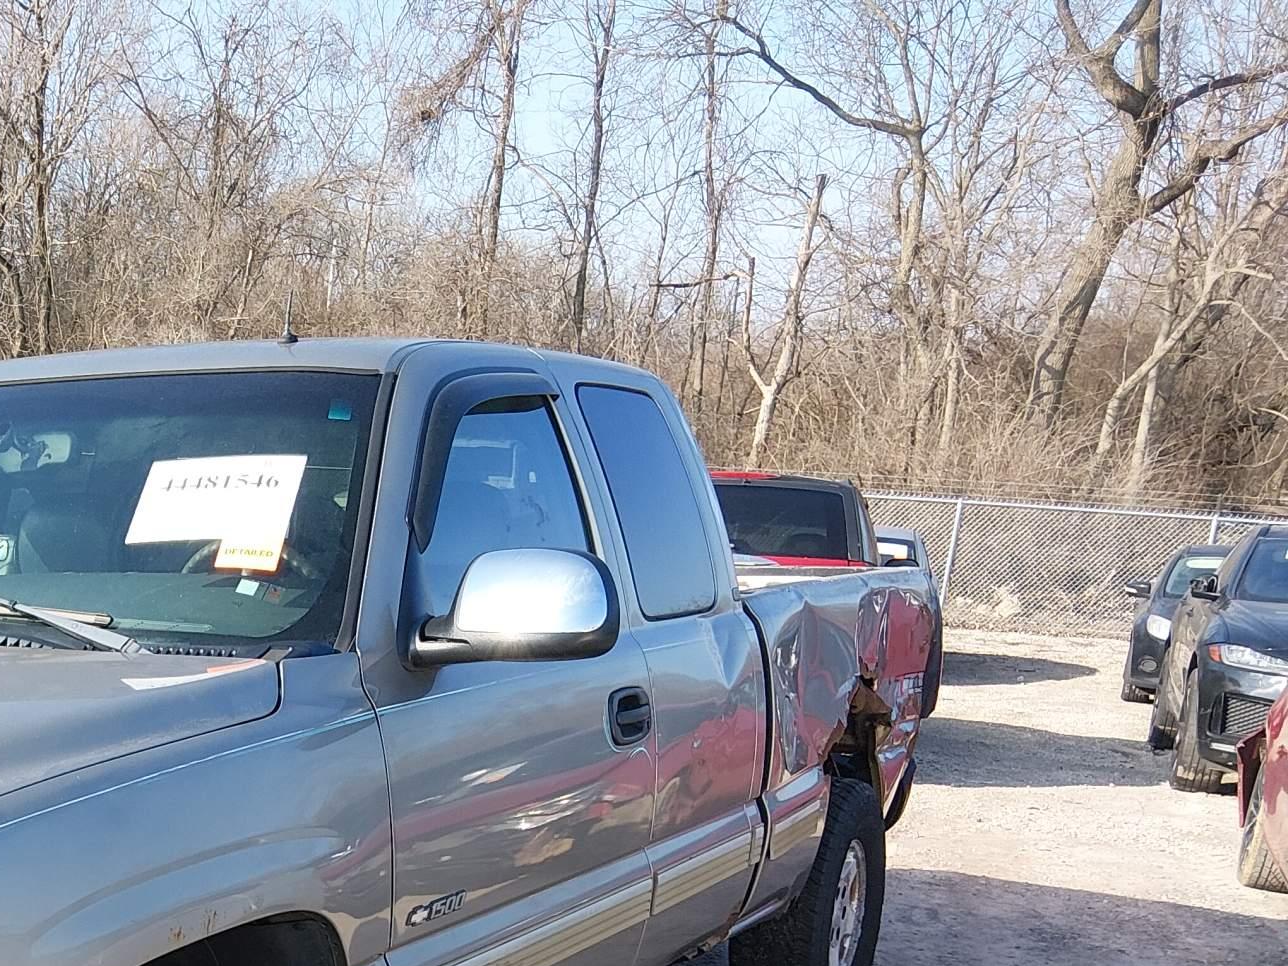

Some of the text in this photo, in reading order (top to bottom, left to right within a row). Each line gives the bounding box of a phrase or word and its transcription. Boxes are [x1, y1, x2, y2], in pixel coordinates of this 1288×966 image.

[161, 472, 281, 492] 44481546
[223, 547, 274, 558] DETAILED
[429, 889, 467, 920] 1500
